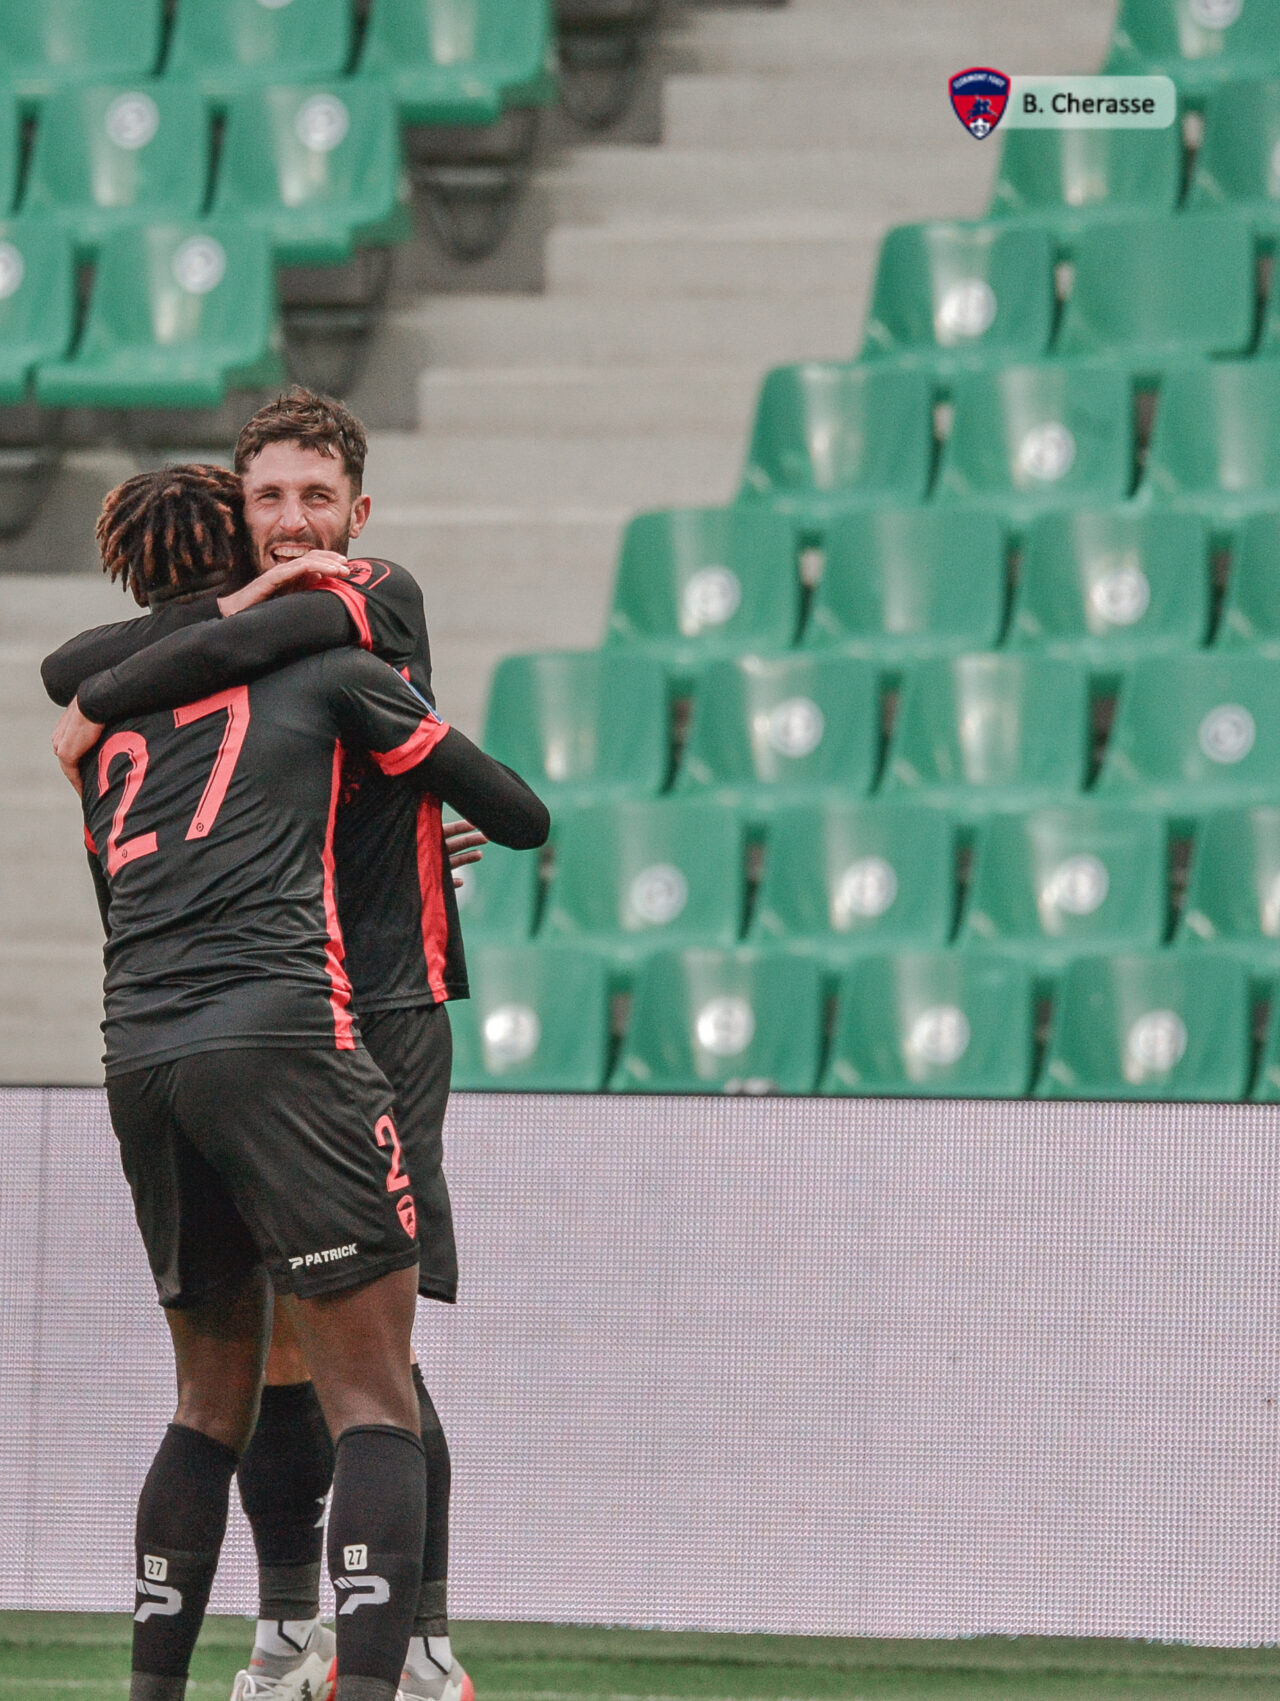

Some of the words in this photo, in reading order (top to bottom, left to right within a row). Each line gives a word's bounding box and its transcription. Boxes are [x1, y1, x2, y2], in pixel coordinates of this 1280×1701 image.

[97, 684, 251, 877] 27
[305, 1243, 358, 1267] PATRICK
[147, 1559, 164, 1577] 27
[348, 1549, 363, 1566] 27
